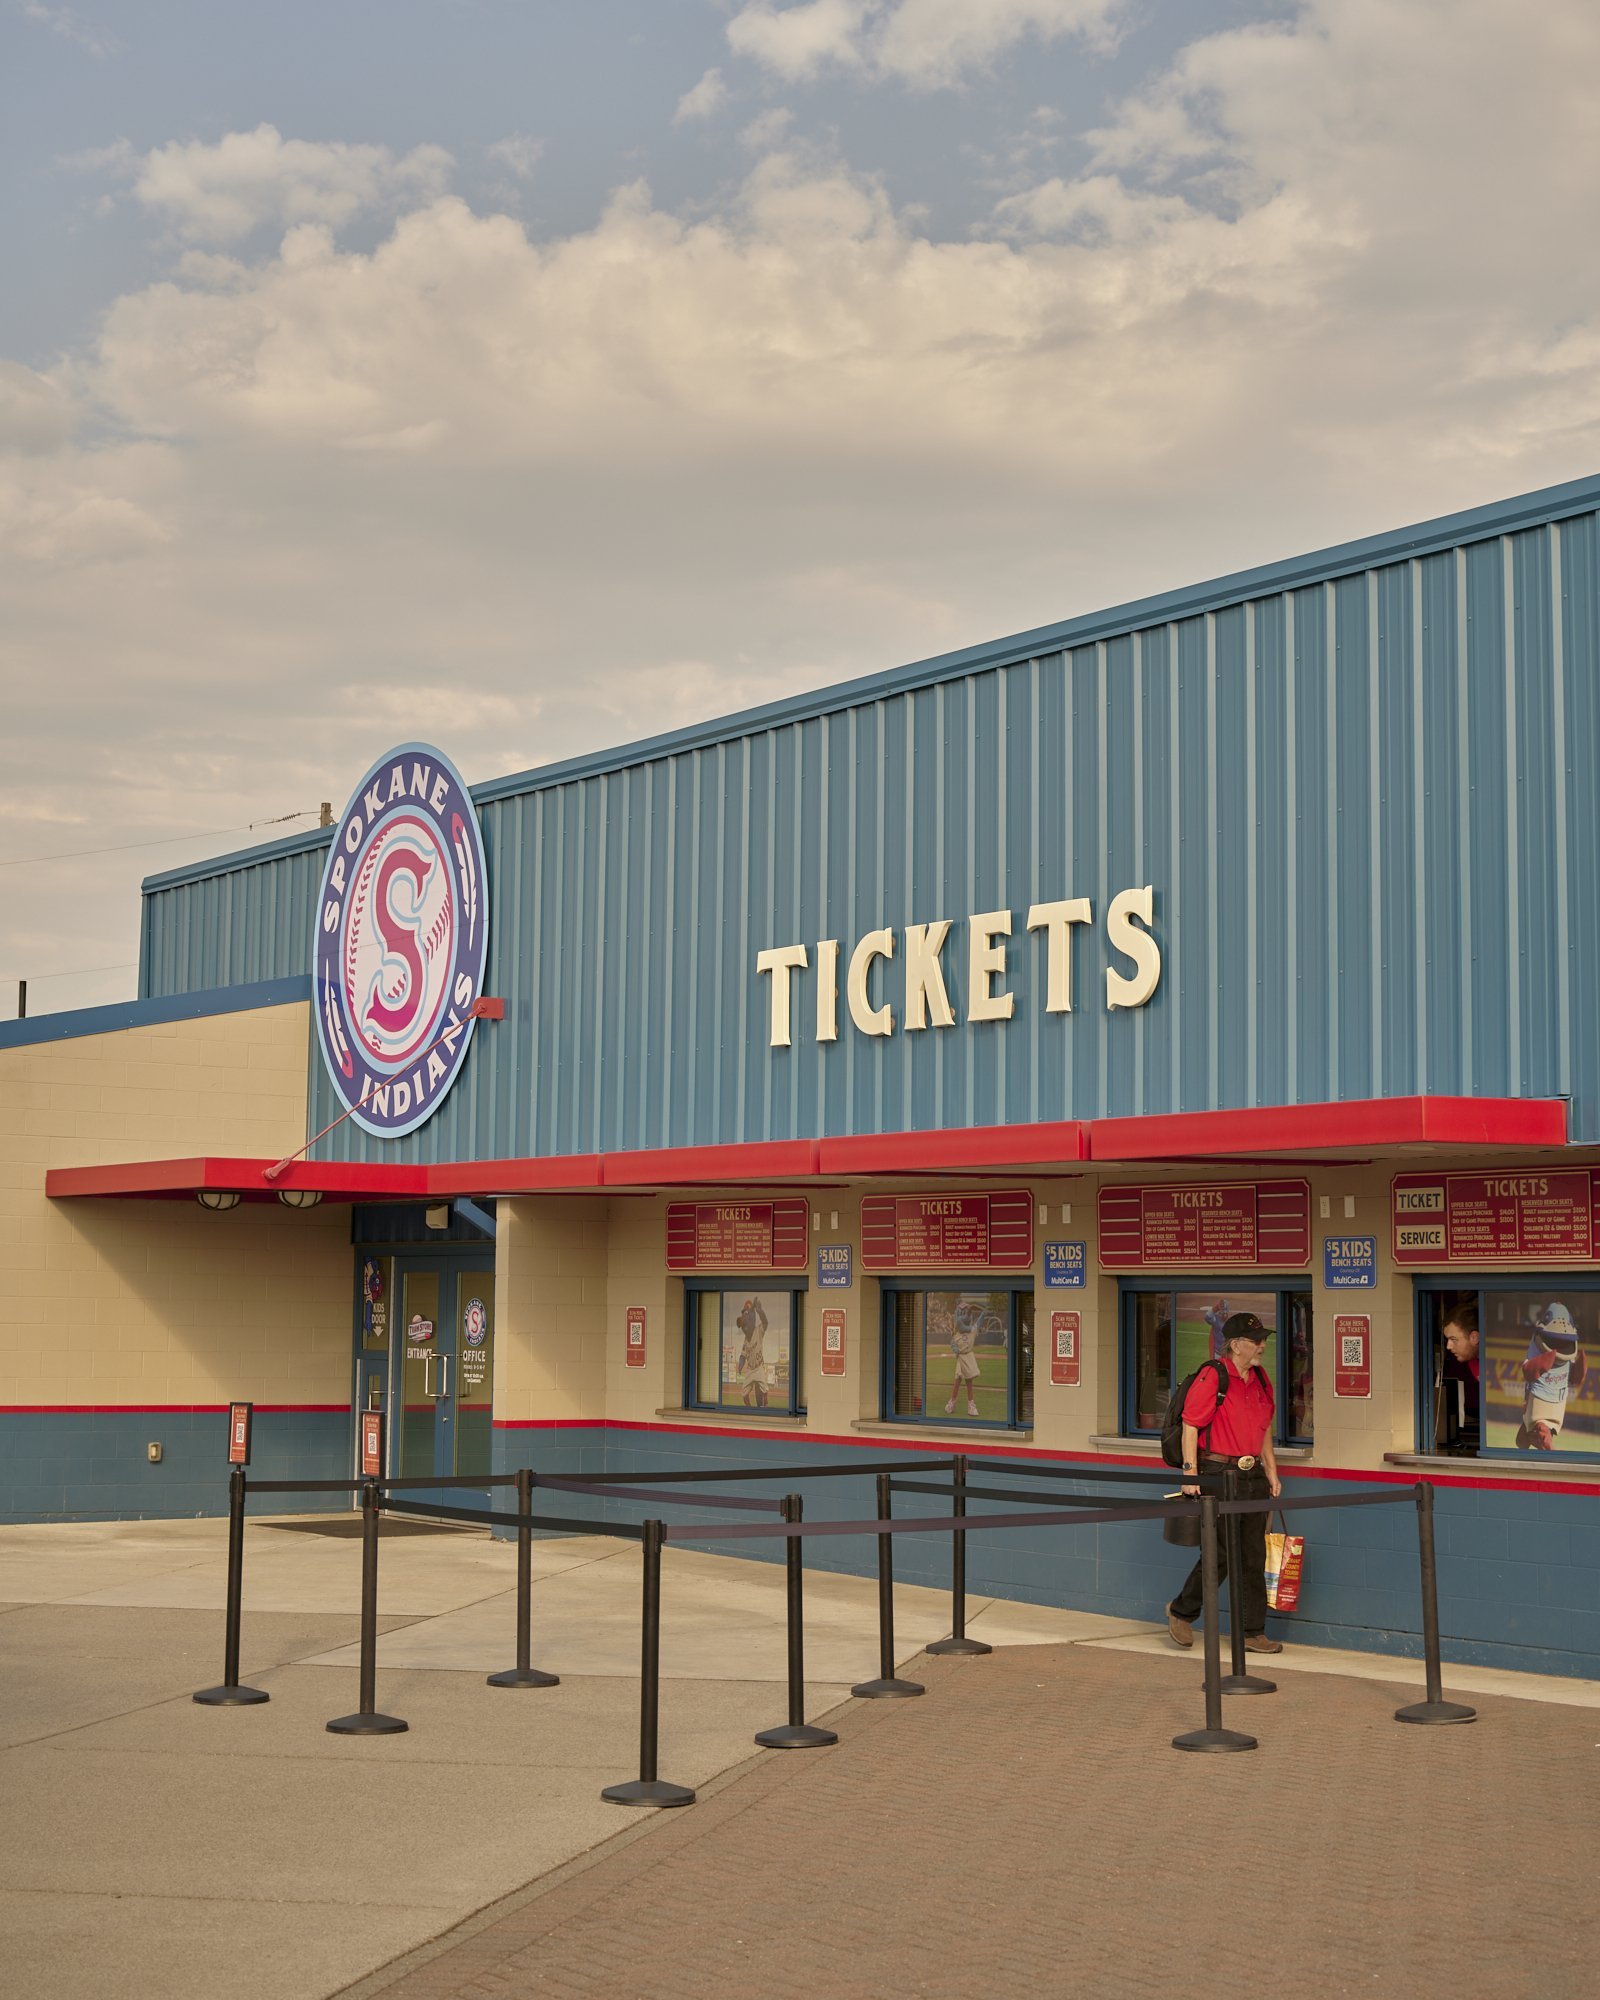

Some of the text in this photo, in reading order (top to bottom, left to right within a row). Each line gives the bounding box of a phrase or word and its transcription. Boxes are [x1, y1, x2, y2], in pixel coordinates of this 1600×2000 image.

[324, 762, 450, 934] SPOKANE
[757, 885, 1161, 1047] TICKETS
[359, 972, 472, 1118] INDIANS
[1484, 1179, 1548, 1196] TICKETS
[1172, 1192, 1223, 1207] TICKETS
[1398, 1193, 1440, 1208] TICKET
[716, 1208, 751, 1220] TICKETS
[920, 1201, 962, 1215] TICKETS
[1401, 1232, 1440, 1244] SERVICE
[819, 1249, 848, 1262] $5 KIDS
[1046, 1246, 1082, 1260] $5 KIDS
[1327, 1241, 1371, 1257] $5 KIDS
[1333, 1276, 1360, 1284] MultiCare
[373, 1303, 384, 1312] KIDS
[372, 1314, 386, 1324] DOOR
[463, 1350, 485, 1362] OFFICE
